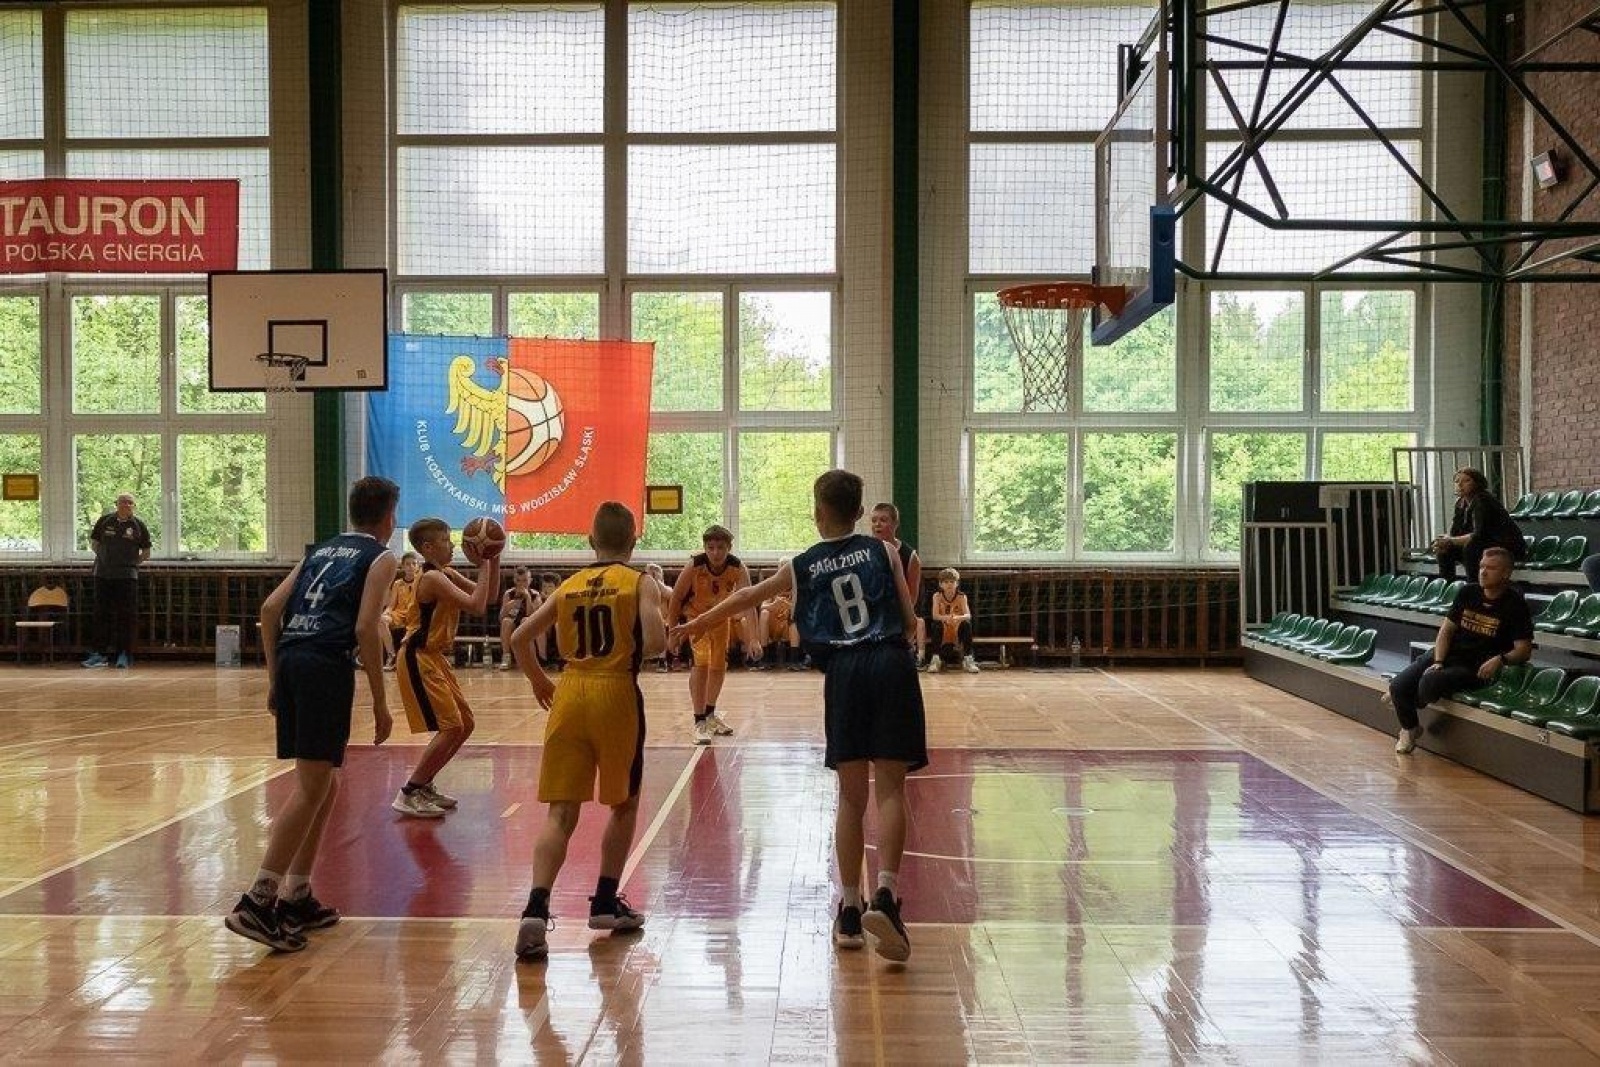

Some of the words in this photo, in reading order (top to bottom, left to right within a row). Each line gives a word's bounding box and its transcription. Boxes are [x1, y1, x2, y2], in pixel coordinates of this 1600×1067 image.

[0, 196, 205, 235] TAURON
[6, 243, 95, 262] POLSKA
[102, 243, 204, 262] ENERGIA
[416, 419, 430, 452] KLUB
[424, 455, 488, 512] KOSZYKARSKI
[491, 504, 517, 515] MKS
[304, 561, 334, 609] 4
[831, 573, 870, 634] 8
[573, 604, 615, 659] 10
